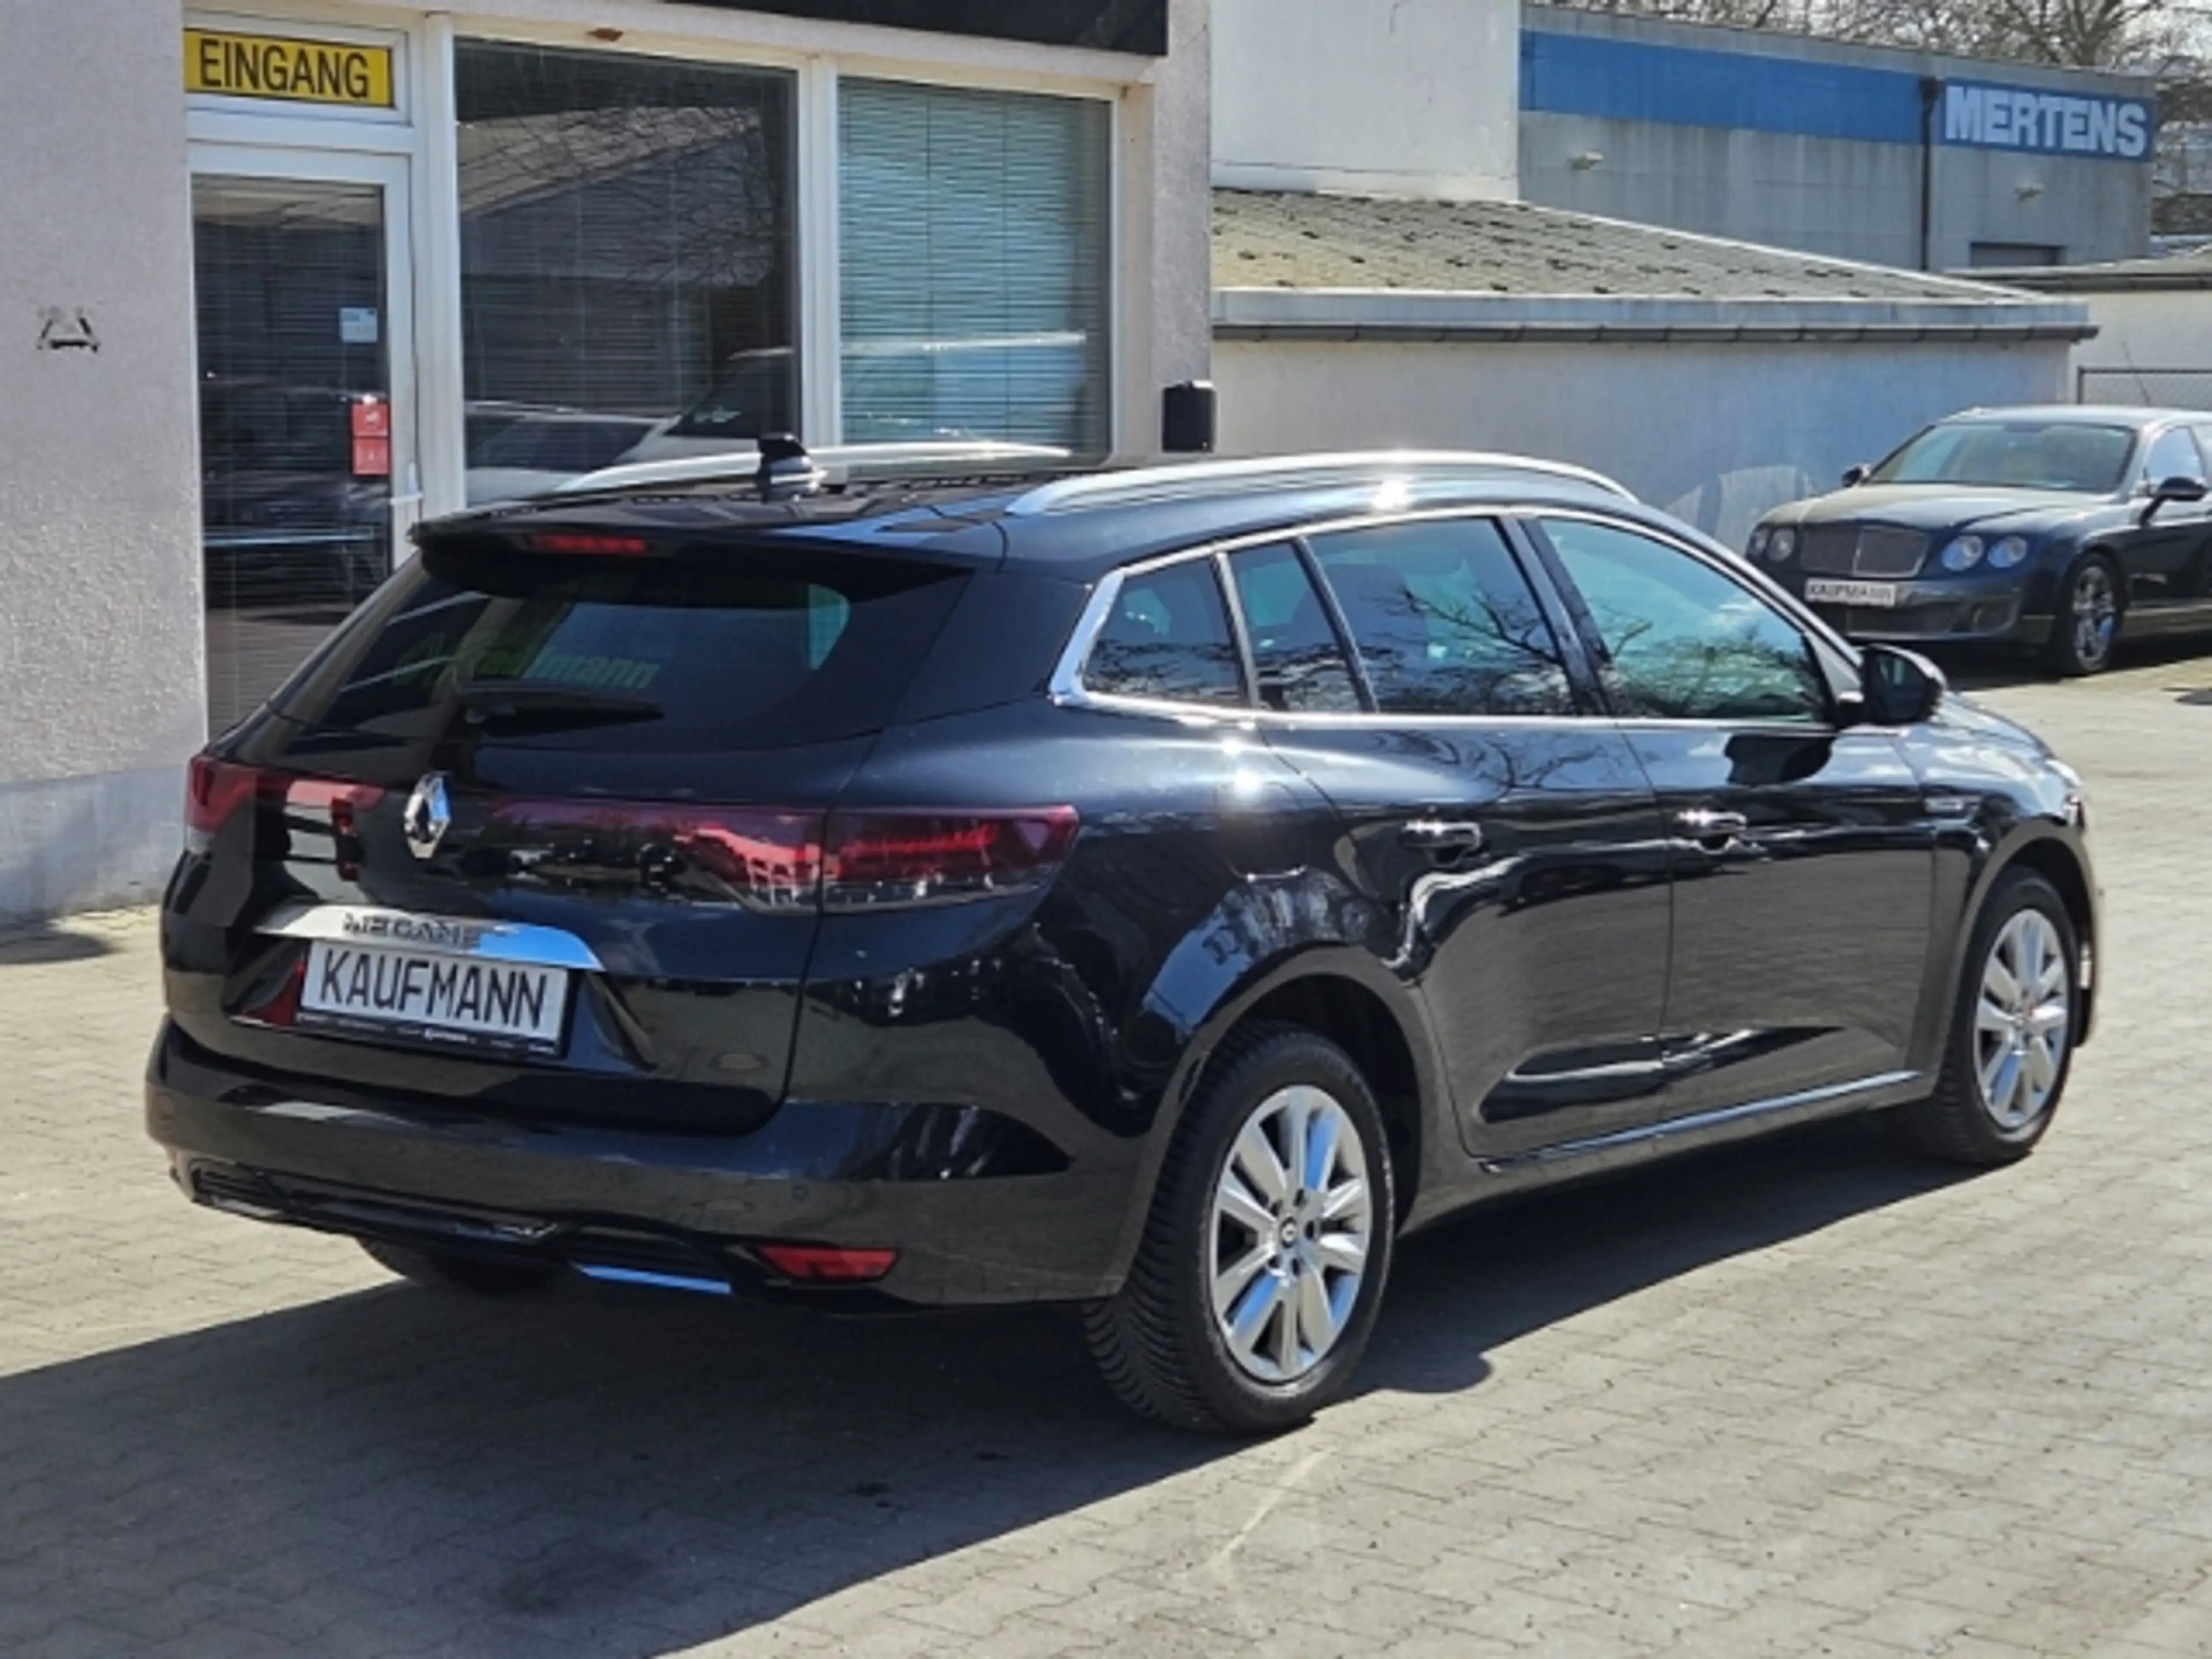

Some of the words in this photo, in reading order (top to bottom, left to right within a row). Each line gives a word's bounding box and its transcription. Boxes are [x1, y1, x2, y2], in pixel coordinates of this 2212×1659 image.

[200, 38, 369, 98] EINGANG
[1945, 86, 2147, 157] MERTENS
[320, 949, 548, 1029] KAUFMANN
